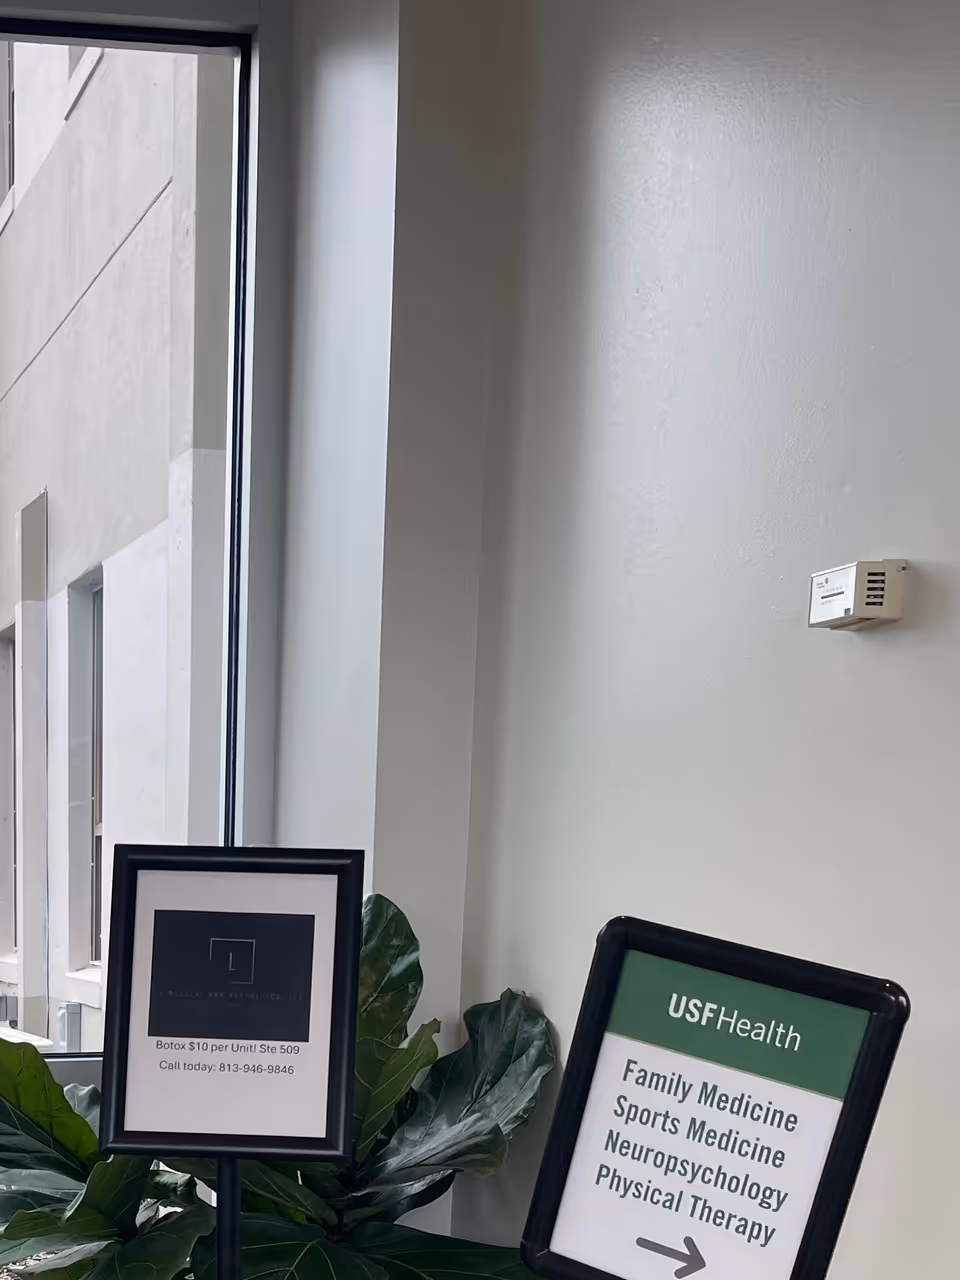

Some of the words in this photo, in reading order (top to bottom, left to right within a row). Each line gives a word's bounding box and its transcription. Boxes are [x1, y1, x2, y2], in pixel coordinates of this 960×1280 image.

[155, 1040, 187, 1051] Botox
[188, 1041, 209, 1052] $10
[210, 1044, 229, 1055] per
[231, 1043, 257, 1053] Unit!
[259, 1044, 277, 1054] Ste
[279, 1045, 300, 1055] 509
[159, 1060, 181, 1071] Call
[183, 1062, 217, 1074] today:
[219, 1063, 295, 1075] 813-946-9846
[613, 1094, 681, 1135] Sports
[686, 1117, 786, 1168] Medicine
[622, 1058, 693, 1104] Family
[697, 1081, 798, 1132] Medicine
[595, 1163, 684, 1212] Physical
[689, 1194, 776, 1248] Therapy
[604, 1129, 788, 1212] Neuropsychology
